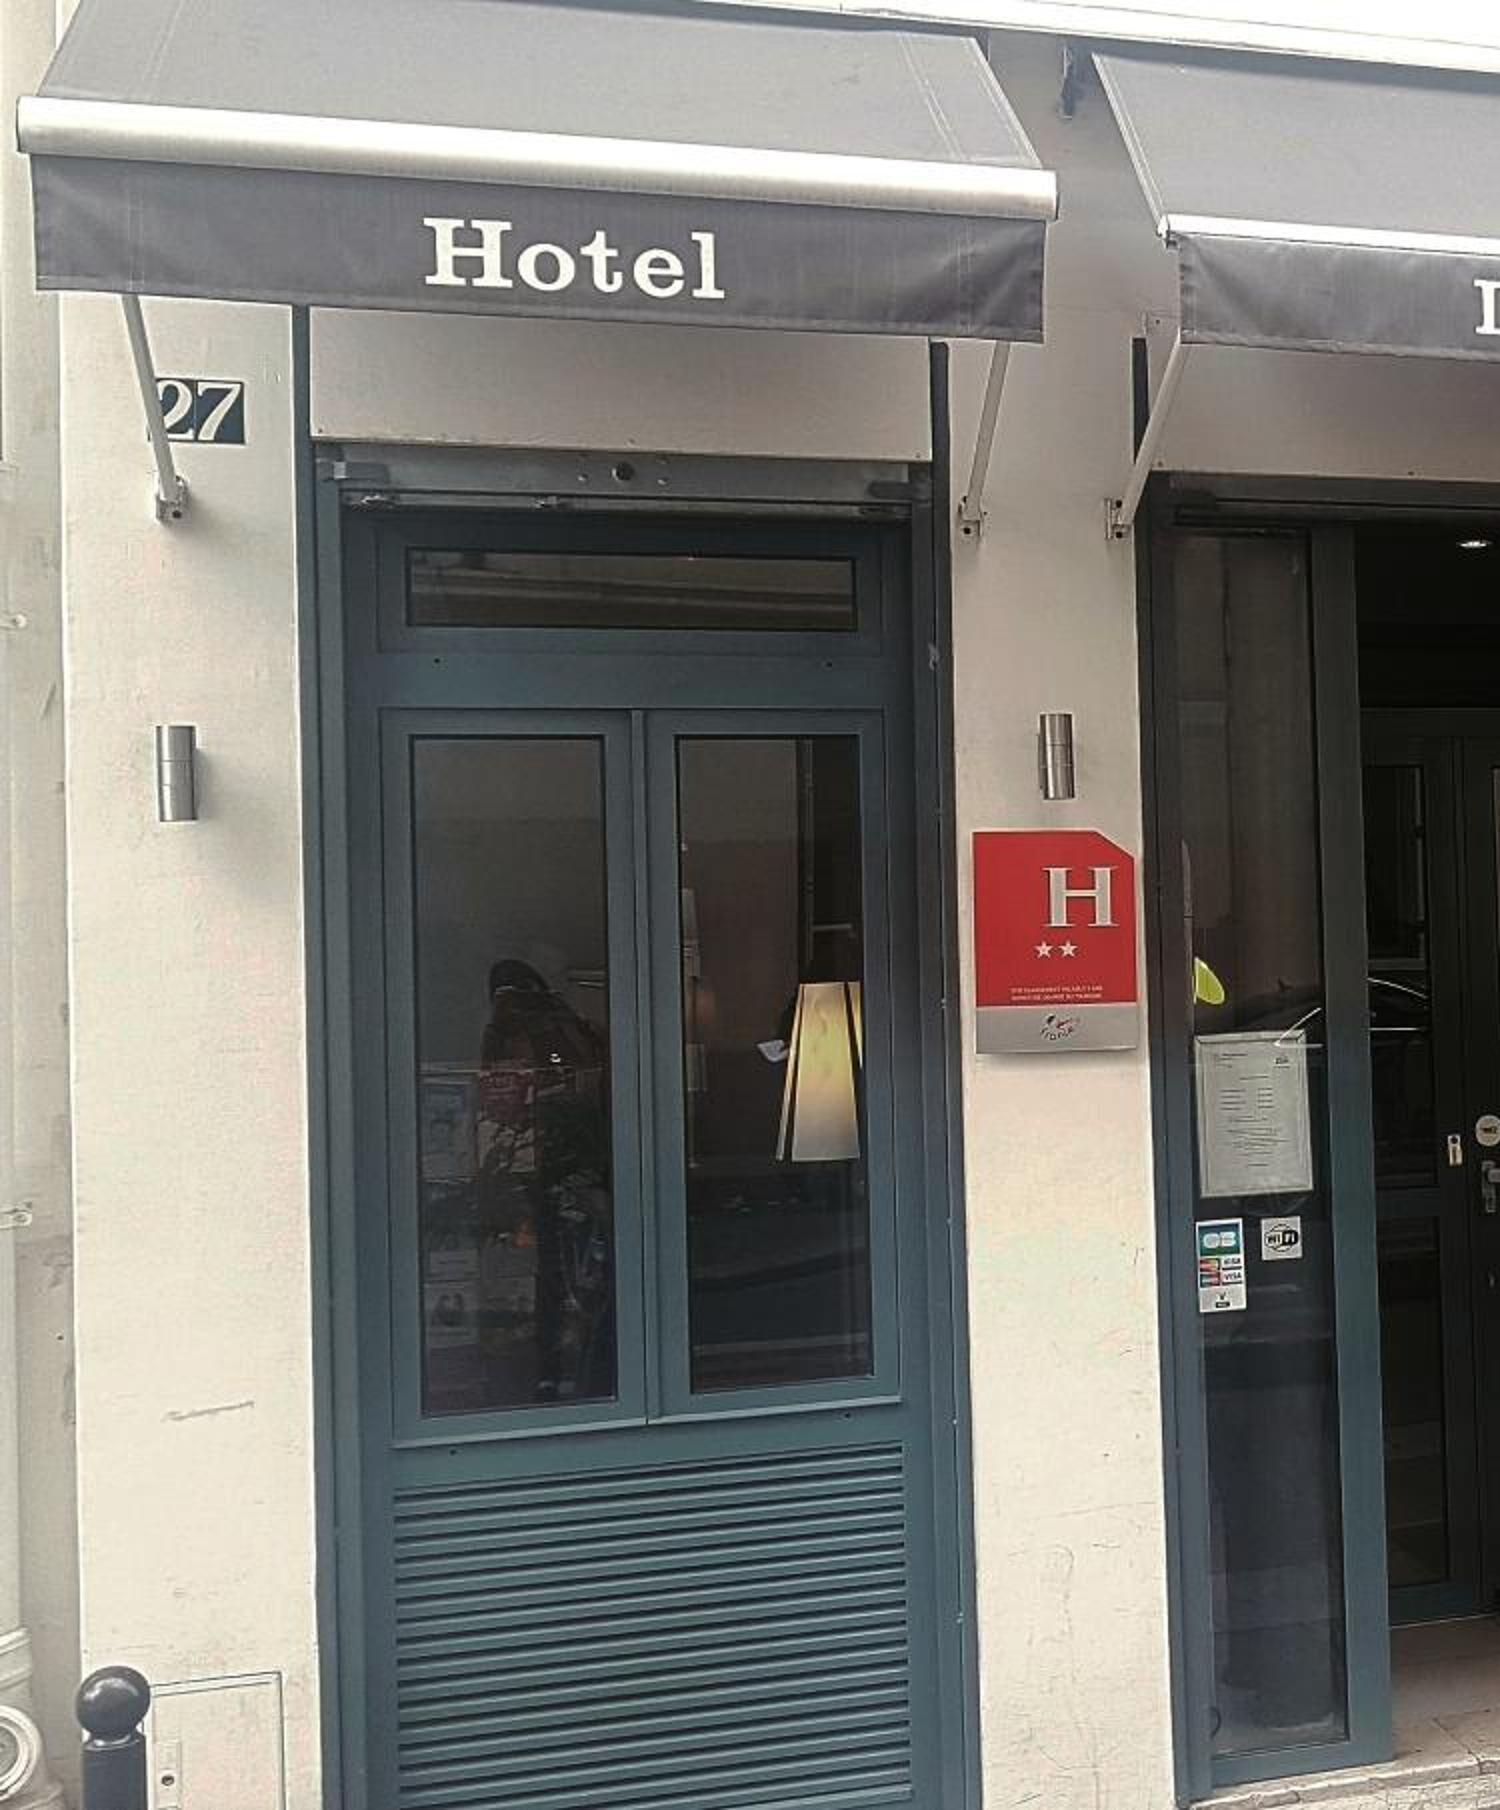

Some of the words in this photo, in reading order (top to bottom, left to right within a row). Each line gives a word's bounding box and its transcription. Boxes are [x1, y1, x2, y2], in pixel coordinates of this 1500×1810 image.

[423, 216, 726, 300] Hotel
[156, 379, 241, 441] 27
[1041, 865, 1121, 928] H
